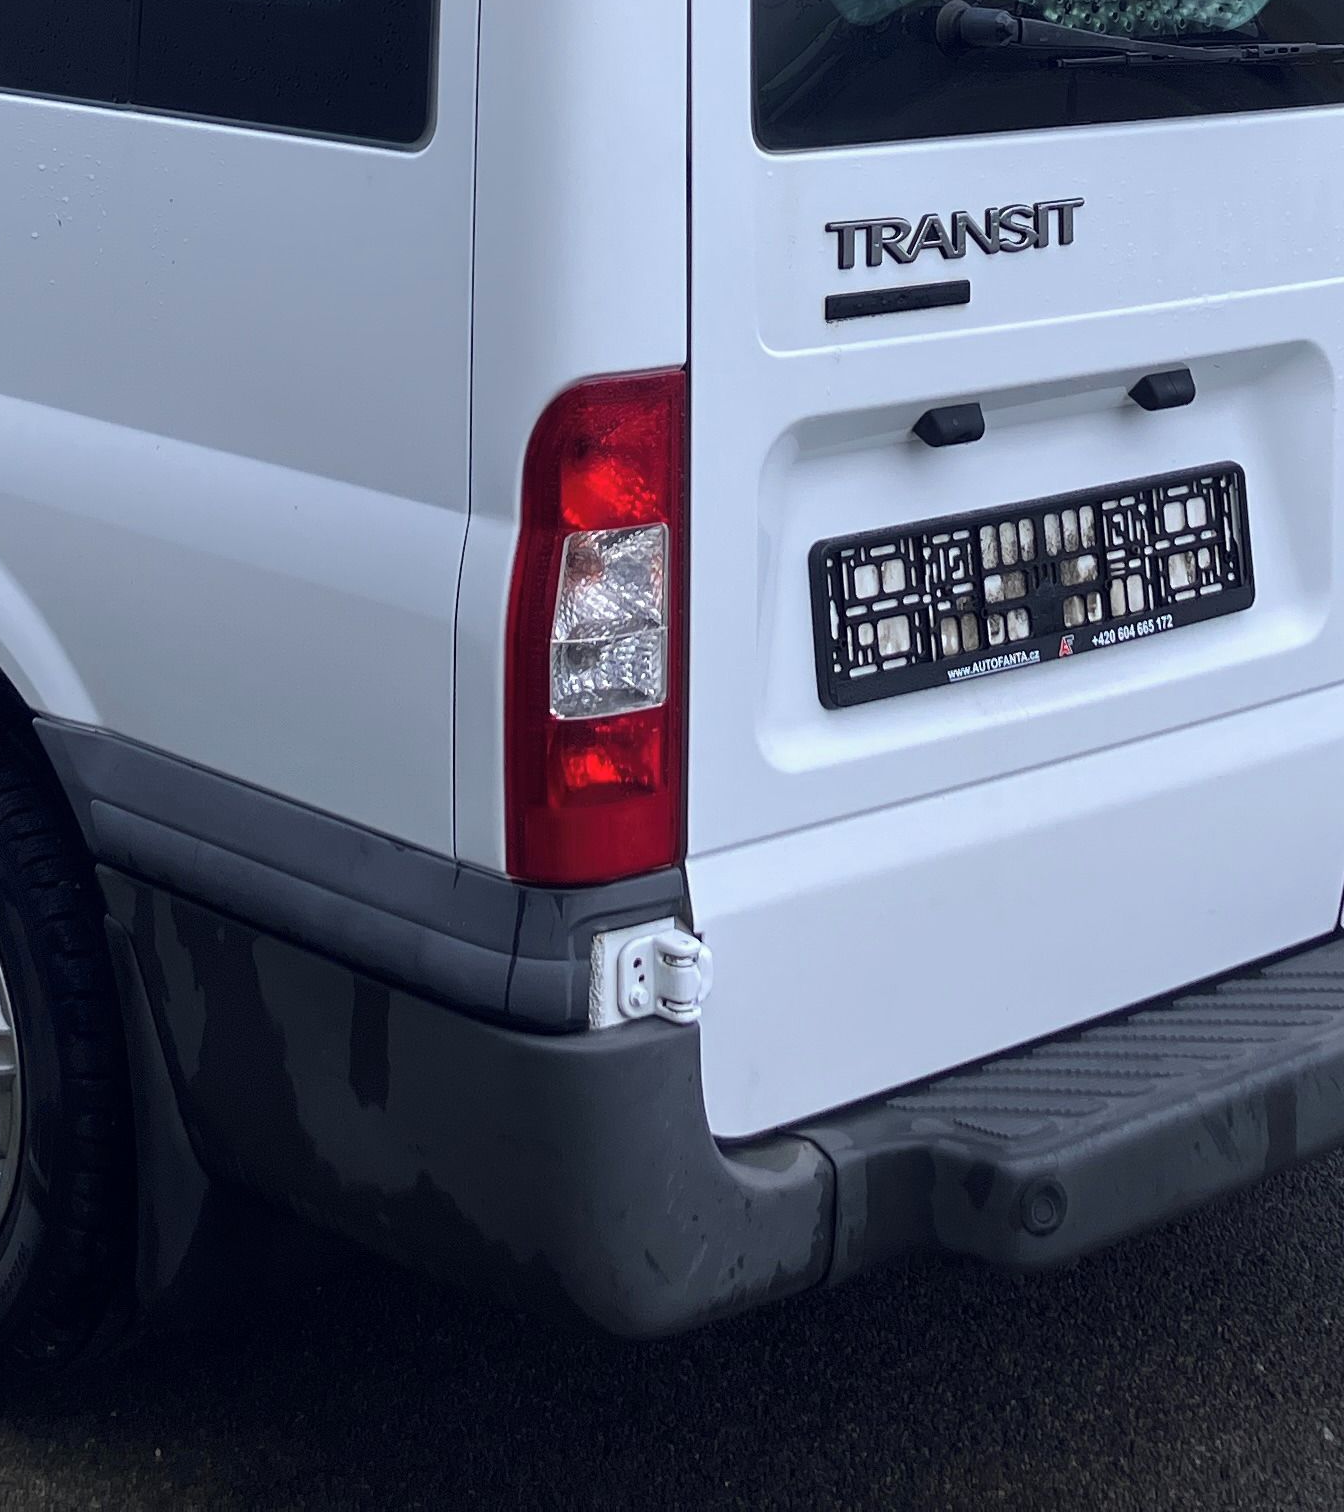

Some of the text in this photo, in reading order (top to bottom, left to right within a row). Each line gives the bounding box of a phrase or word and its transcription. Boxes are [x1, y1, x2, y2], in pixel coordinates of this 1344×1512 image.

[824, 196, 1085, 270] TRANSIT
[1091, 614, 1174, 647] +420 604 665 172
[947, 649, 1040, 682] www.AUTOFANTA.cz
